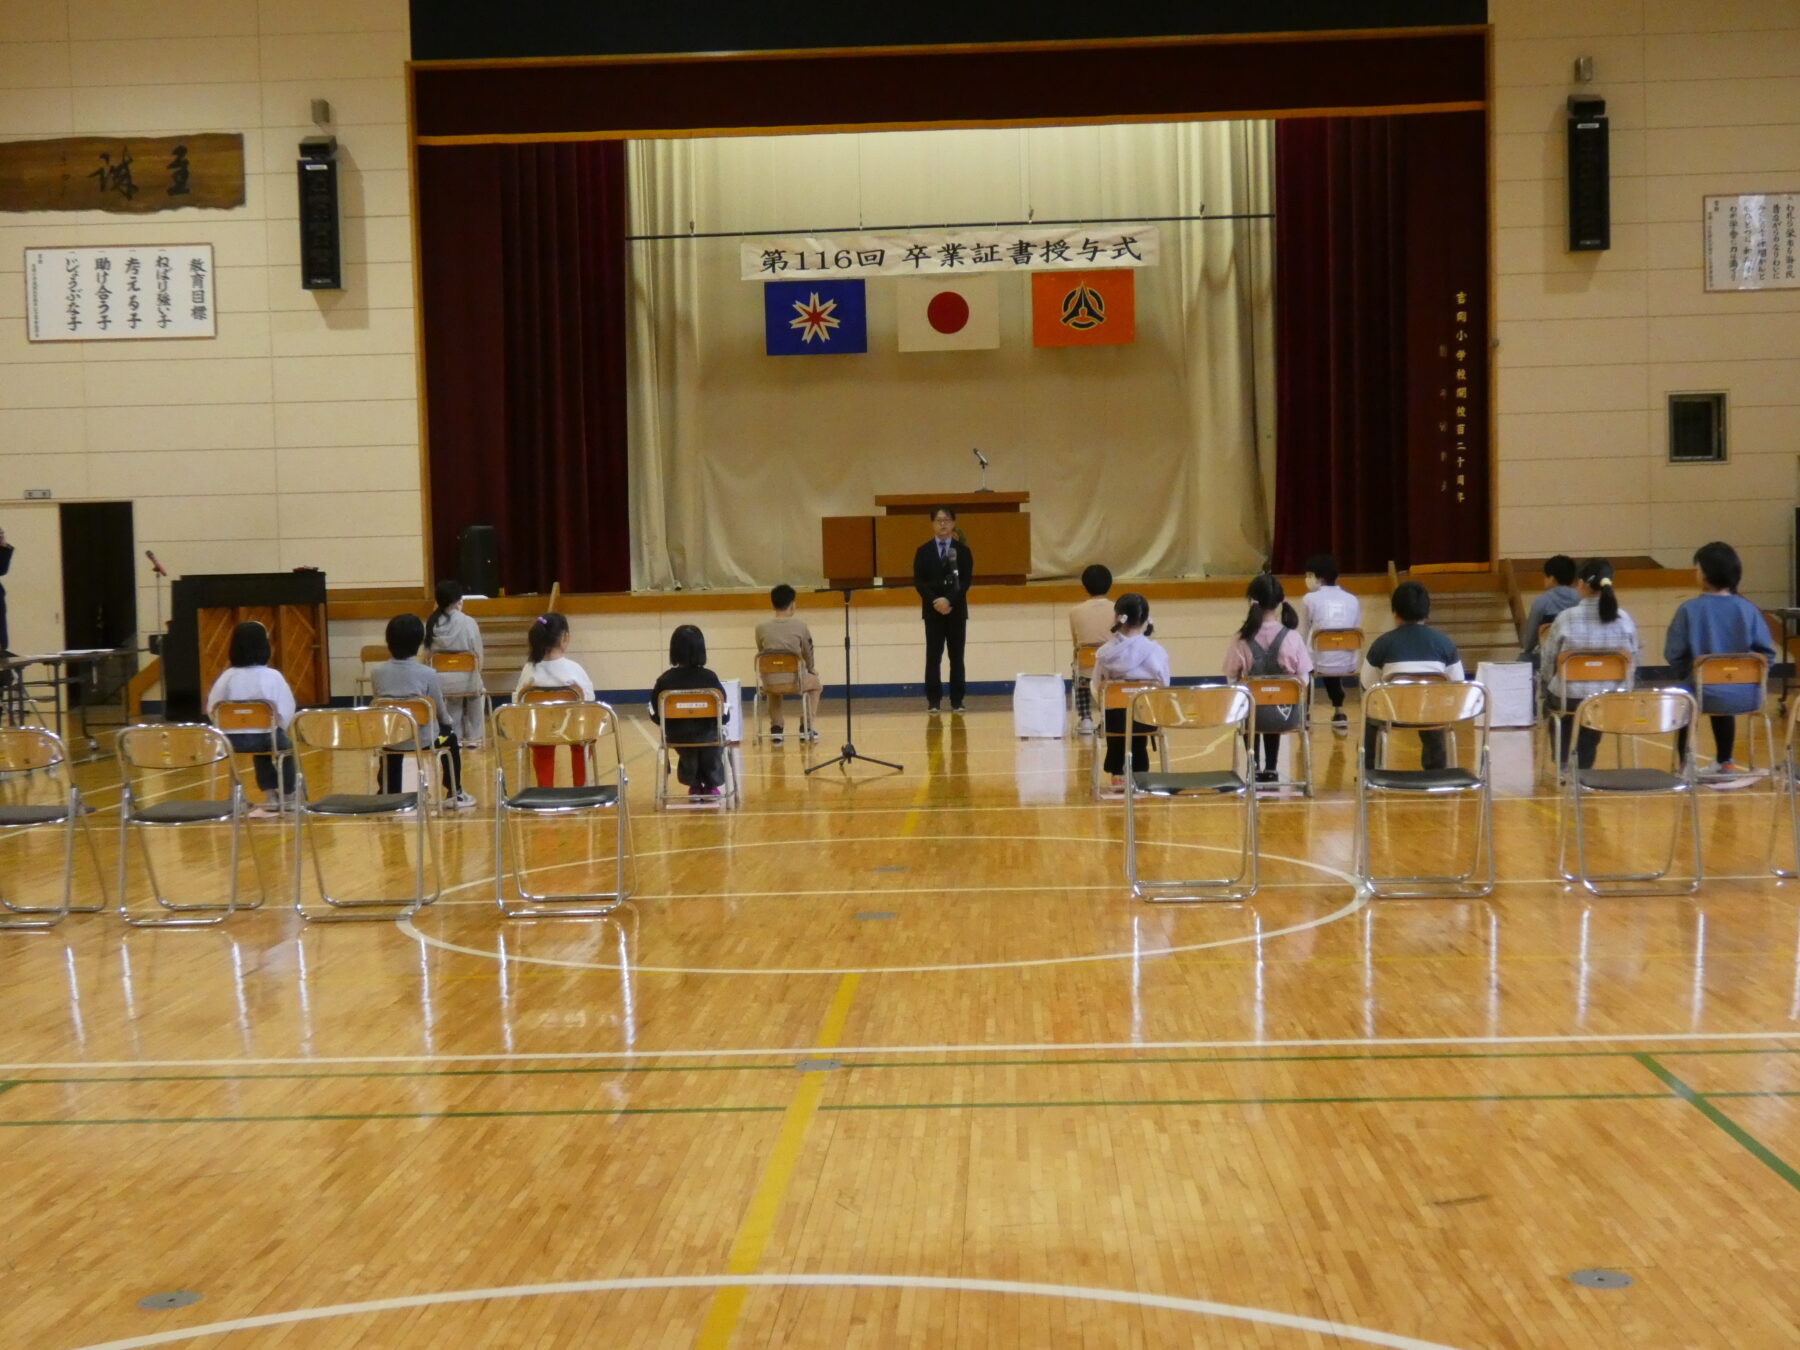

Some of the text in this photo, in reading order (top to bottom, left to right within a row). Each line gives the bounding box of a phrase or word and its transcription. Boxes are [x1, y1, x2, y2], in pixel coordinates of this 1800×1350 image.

[759, 235, 1143, 274] 第116回 卒業証書授与式
[189, 258, 207, 321] 教育目標
